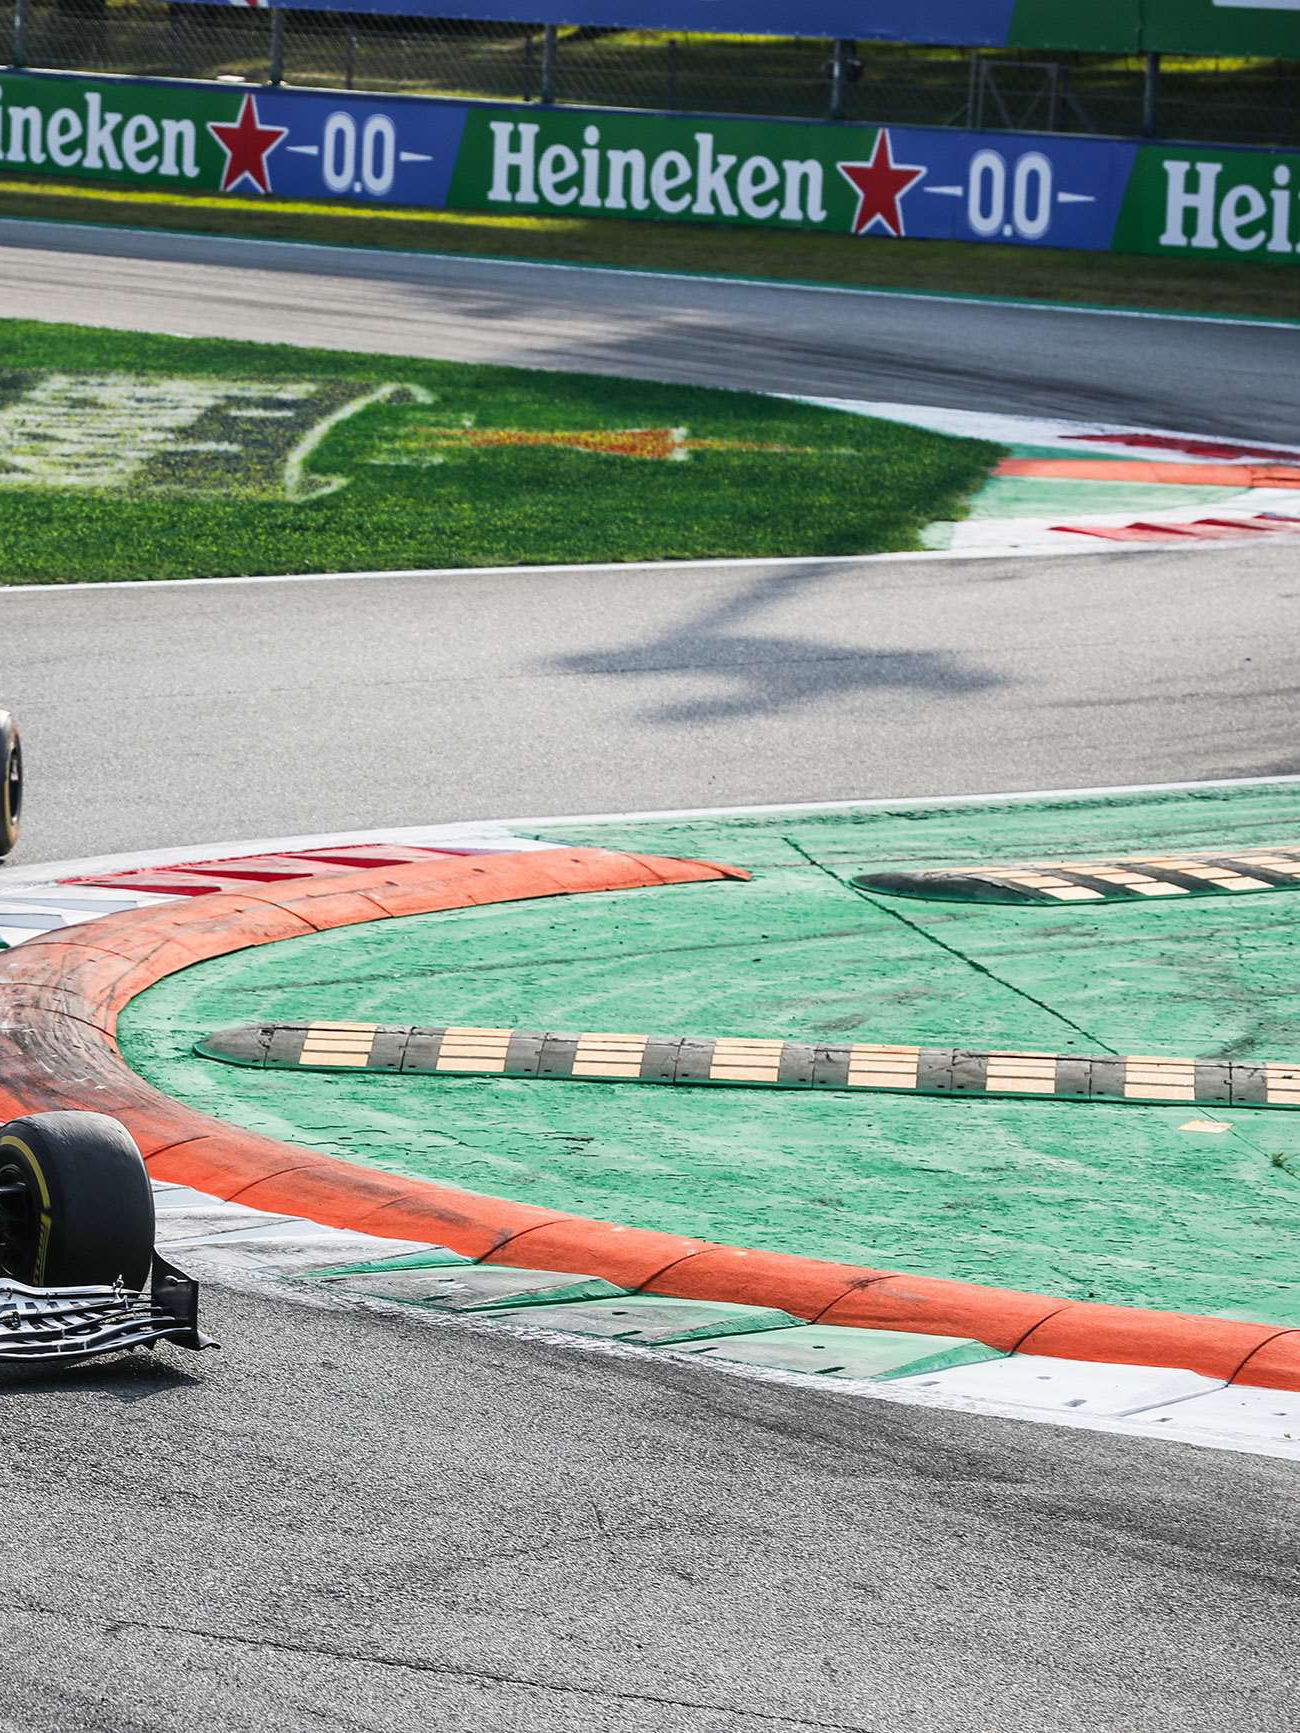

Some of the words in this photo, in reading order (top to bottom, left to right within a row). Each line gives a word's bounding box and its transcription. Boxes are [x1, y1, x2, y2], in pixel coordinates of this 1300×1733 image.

[323, 111, 396, 197] 0.0
[487, 120, 827, 222] Heineken
[968, 148, 1053, 239] 0.0
[1158, 159, 1300, 256] Hei
